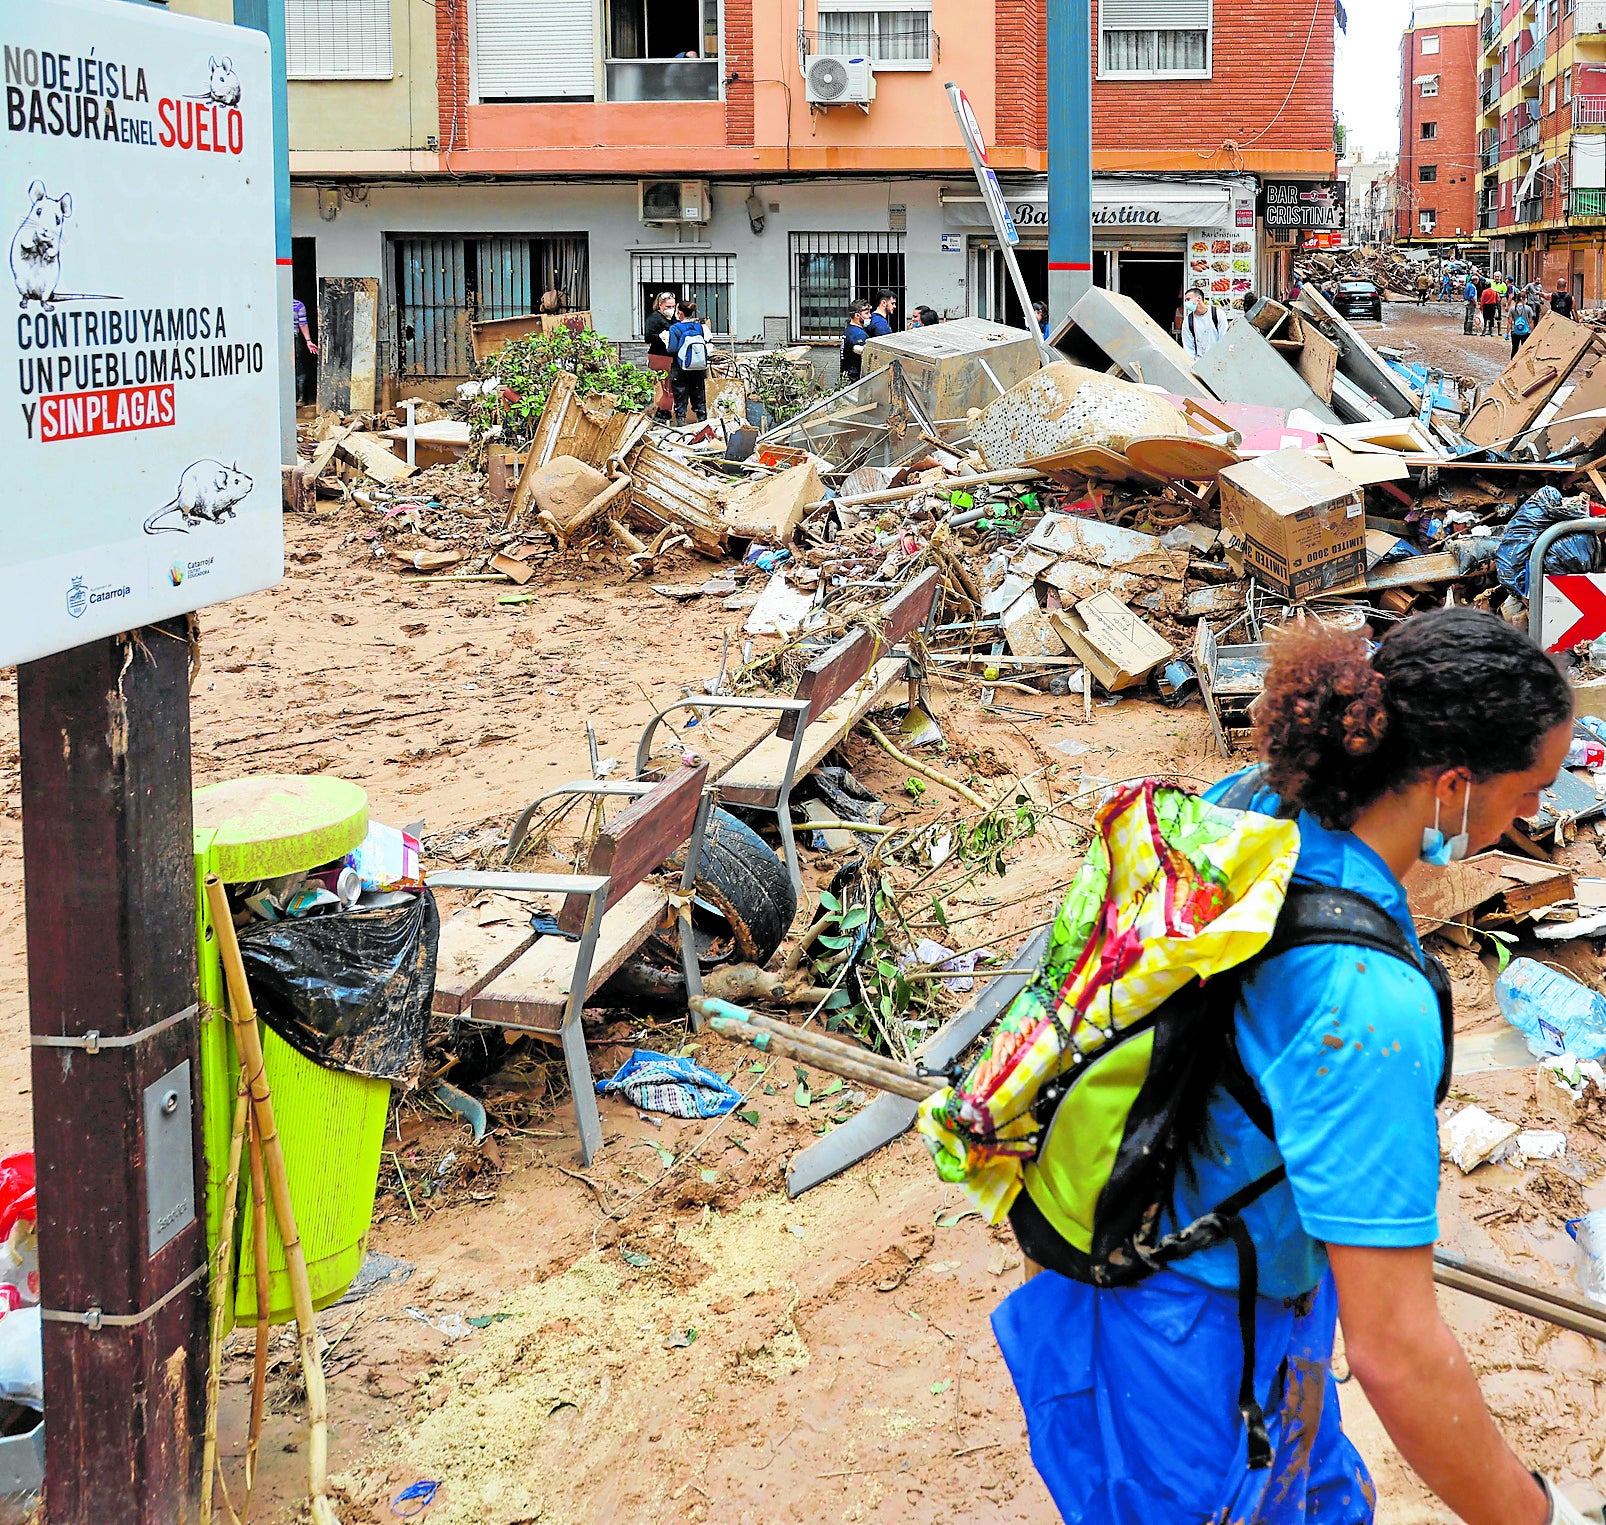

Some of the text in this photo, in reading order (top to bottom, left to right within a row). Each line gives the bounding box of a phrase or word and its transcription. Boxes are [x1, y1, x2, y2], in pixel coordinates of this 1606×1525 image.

[4, 44, 149, 103] NO DEJÉIS LA
[6, 86, 244, 155] BASURA EN EL SUELO
[1267, 185, 1298, 204] BAR
[1013, 203, 1161, 224] Ba ristina
[1266, 206, 1335, 225] CRISTINA
[17, 306, 226, 350] CONTRIBUYAMOS A
[18, 340, 263, 395] UN PUEBLO MÁS LIMPIO
[21, 386, 174, 440] Y SIN PLAGAS
[1307, 548, 1329, 563] 3000
[1332, 536, 1363, 554] LIMITED
[1255, 551, 1288, 580] LIMITED
[89, 586, 131, 604] Catarroja
